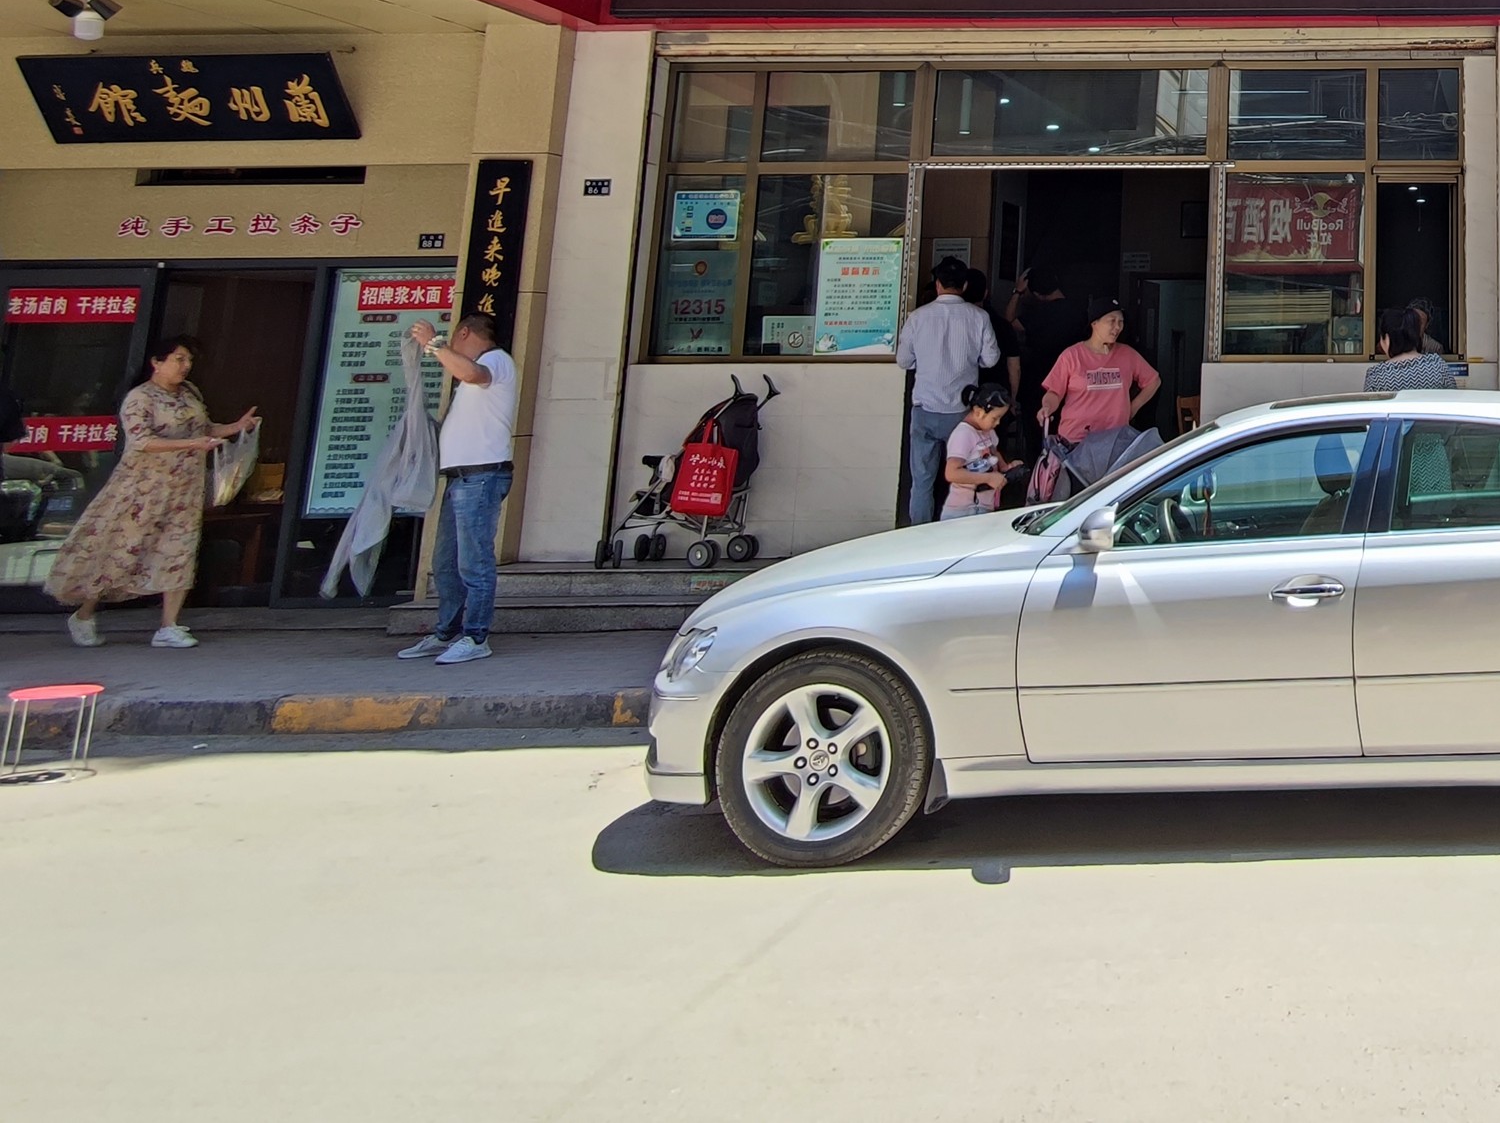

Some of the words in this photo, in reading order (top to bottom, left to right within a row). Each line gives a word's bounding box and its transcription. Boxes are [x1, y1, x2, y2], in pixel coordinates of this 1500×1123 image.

[118, 213, 362, 238] 纯手工拉条子
[362, 286, 442, 305] 招牌浆水面
[8, 296, 68, 315] 老汤卤肉
[77, 296, 137, 315] 干拌拉条
[671, 299, 726, 315] 12315
[58, 424, 119, 443] 干拌拉条
